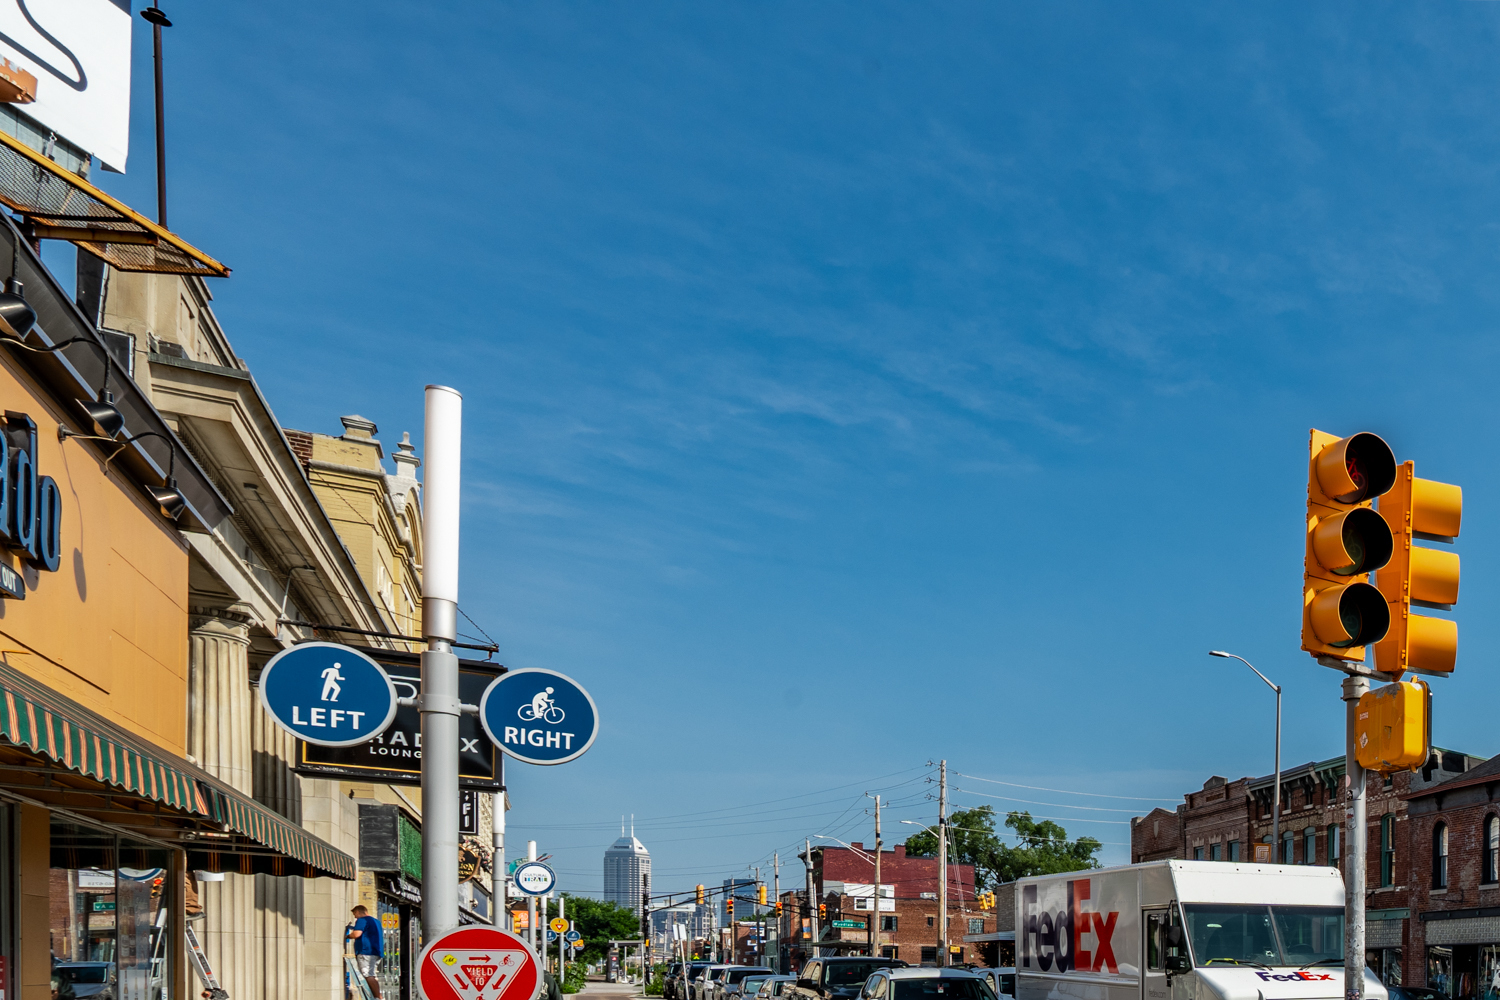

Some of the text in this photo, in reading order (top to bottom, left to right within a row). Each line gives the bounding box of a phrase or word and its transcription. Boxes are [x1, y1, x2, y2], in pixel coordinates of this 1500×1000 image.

[292, 706, 365, 730] LEFT
[504, 726, 574, 750] RIGHT
[370, 746, 422, 759] LOUNG
[1023, 878, 1120, 974] FedEx
[466, 967, 493, 976] YIELD
[1255, 972, 1336, 982] FedEx
[475, 977, 484, 986] TO
